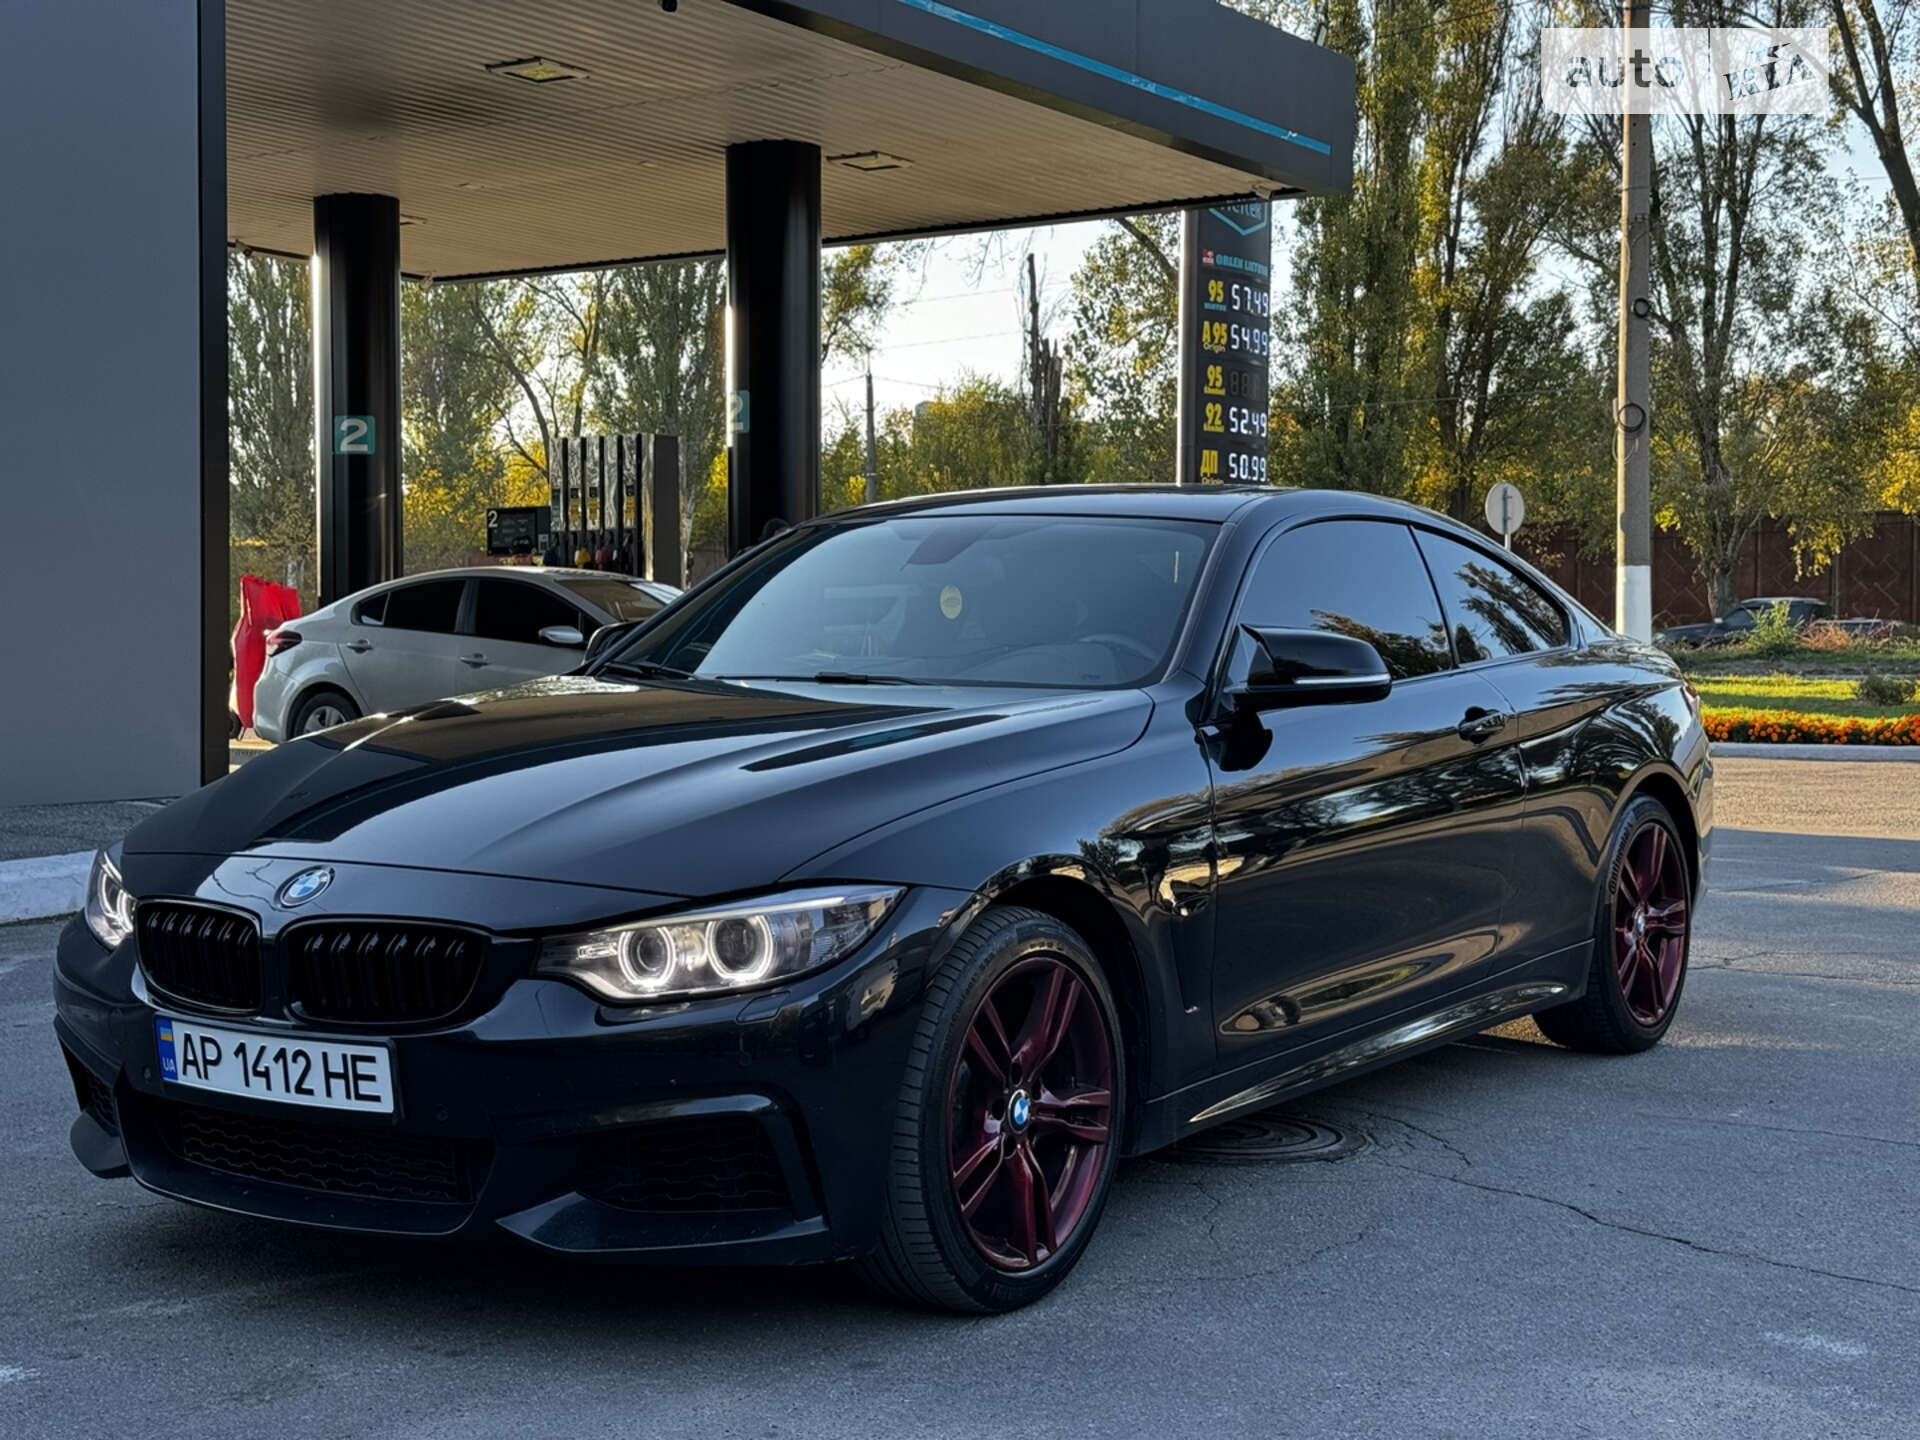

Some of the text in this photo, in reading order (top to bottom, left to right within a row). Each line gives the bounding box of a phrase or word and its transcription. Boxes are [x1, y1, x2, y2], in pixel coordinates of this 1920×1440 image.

[1208, 279, 1269, 317] 95 57.49
[1231, 324, 1268, 355] 54.99
[1207, 365, 1223, 387] 95
[340, 418, 368, 452] 2
[1205, 402, 1267, 437] 92 52.49
[1229, 453, 1266, 482] 50.99
[488, 510, 498, 528] 2
[162, 1058, 177, 1073] UA
[182, 1033, 382, 1103] AP 1412 HE
